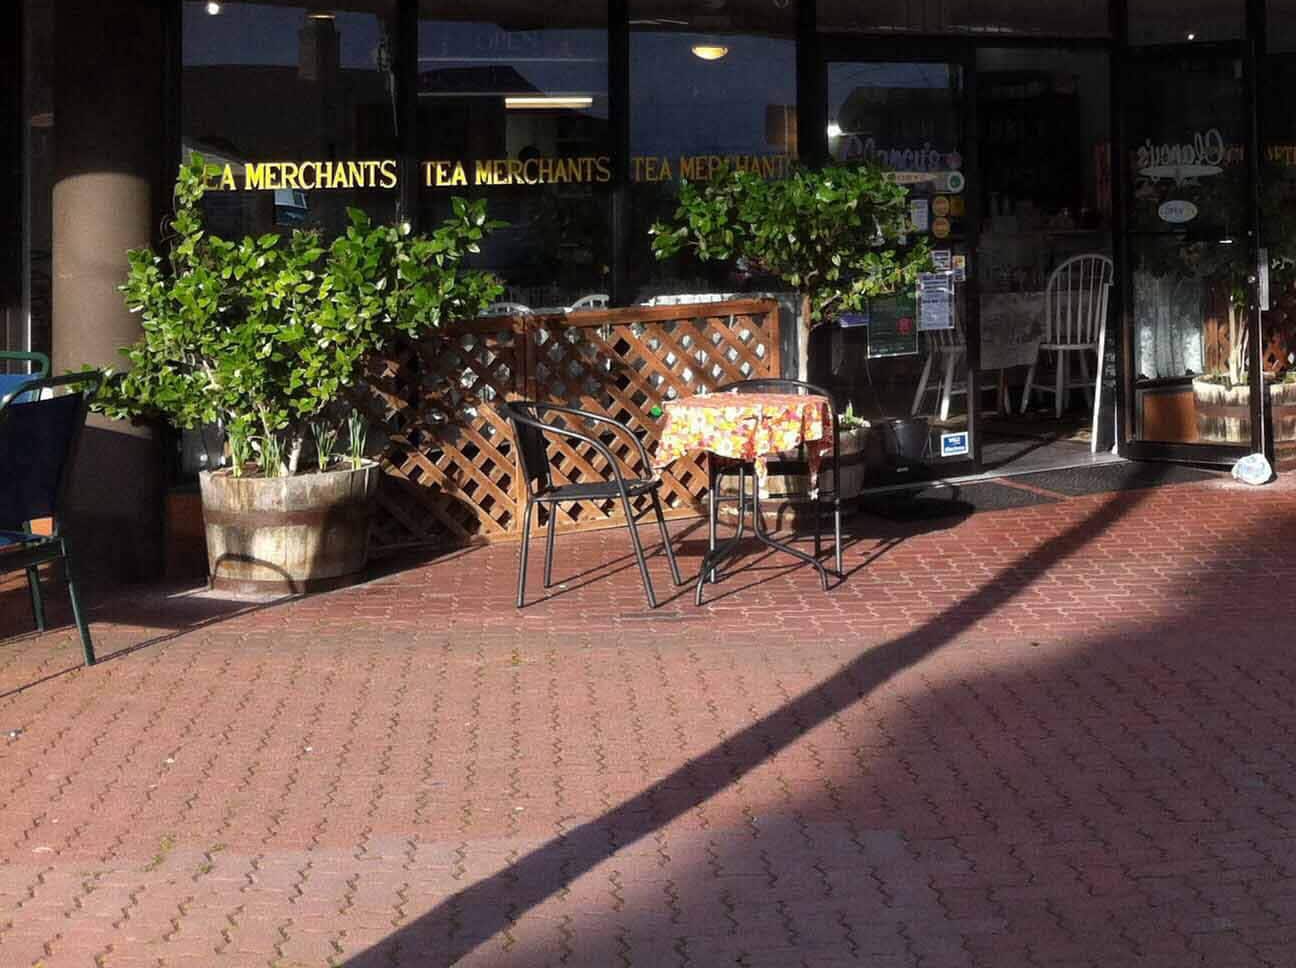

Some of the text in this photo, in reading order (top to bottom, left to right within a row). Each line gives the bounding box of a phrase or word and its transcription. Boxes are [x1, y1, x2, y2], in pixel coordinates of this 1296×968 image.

[200, 160, 397, 192] EA MERCHANTS
[421, 156, 611, 187] TEA MERCHANTS
[632, 155, 797, 182] TEA MERHANT
